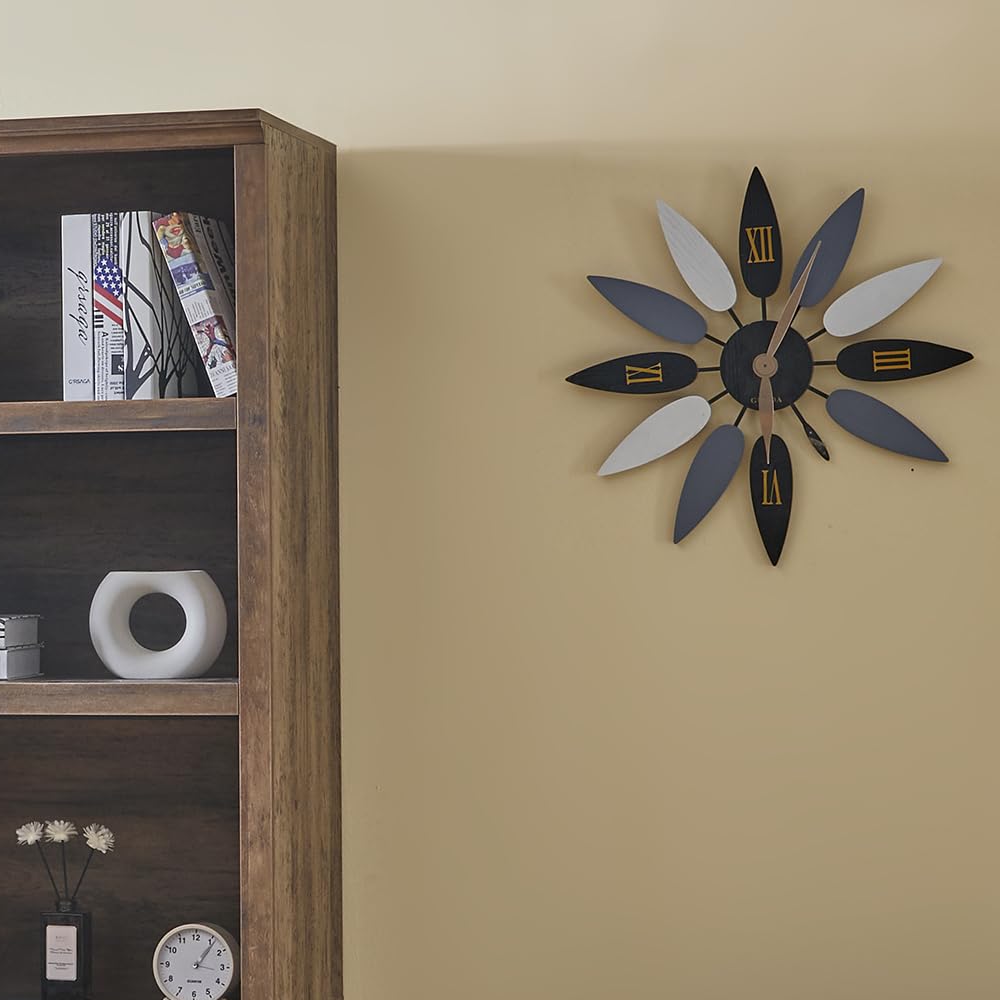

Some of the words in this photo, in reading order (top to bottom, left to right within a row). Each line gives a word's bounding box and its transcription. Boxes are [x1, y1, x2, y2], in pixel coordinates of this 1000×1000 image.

[745, 226, 775, 264] XII
[873, 348, 911, 372] III
[625, 362, 662, 385] IX
[761, 469, 782, 505] VI
[192, 934, 201, 942] 12
